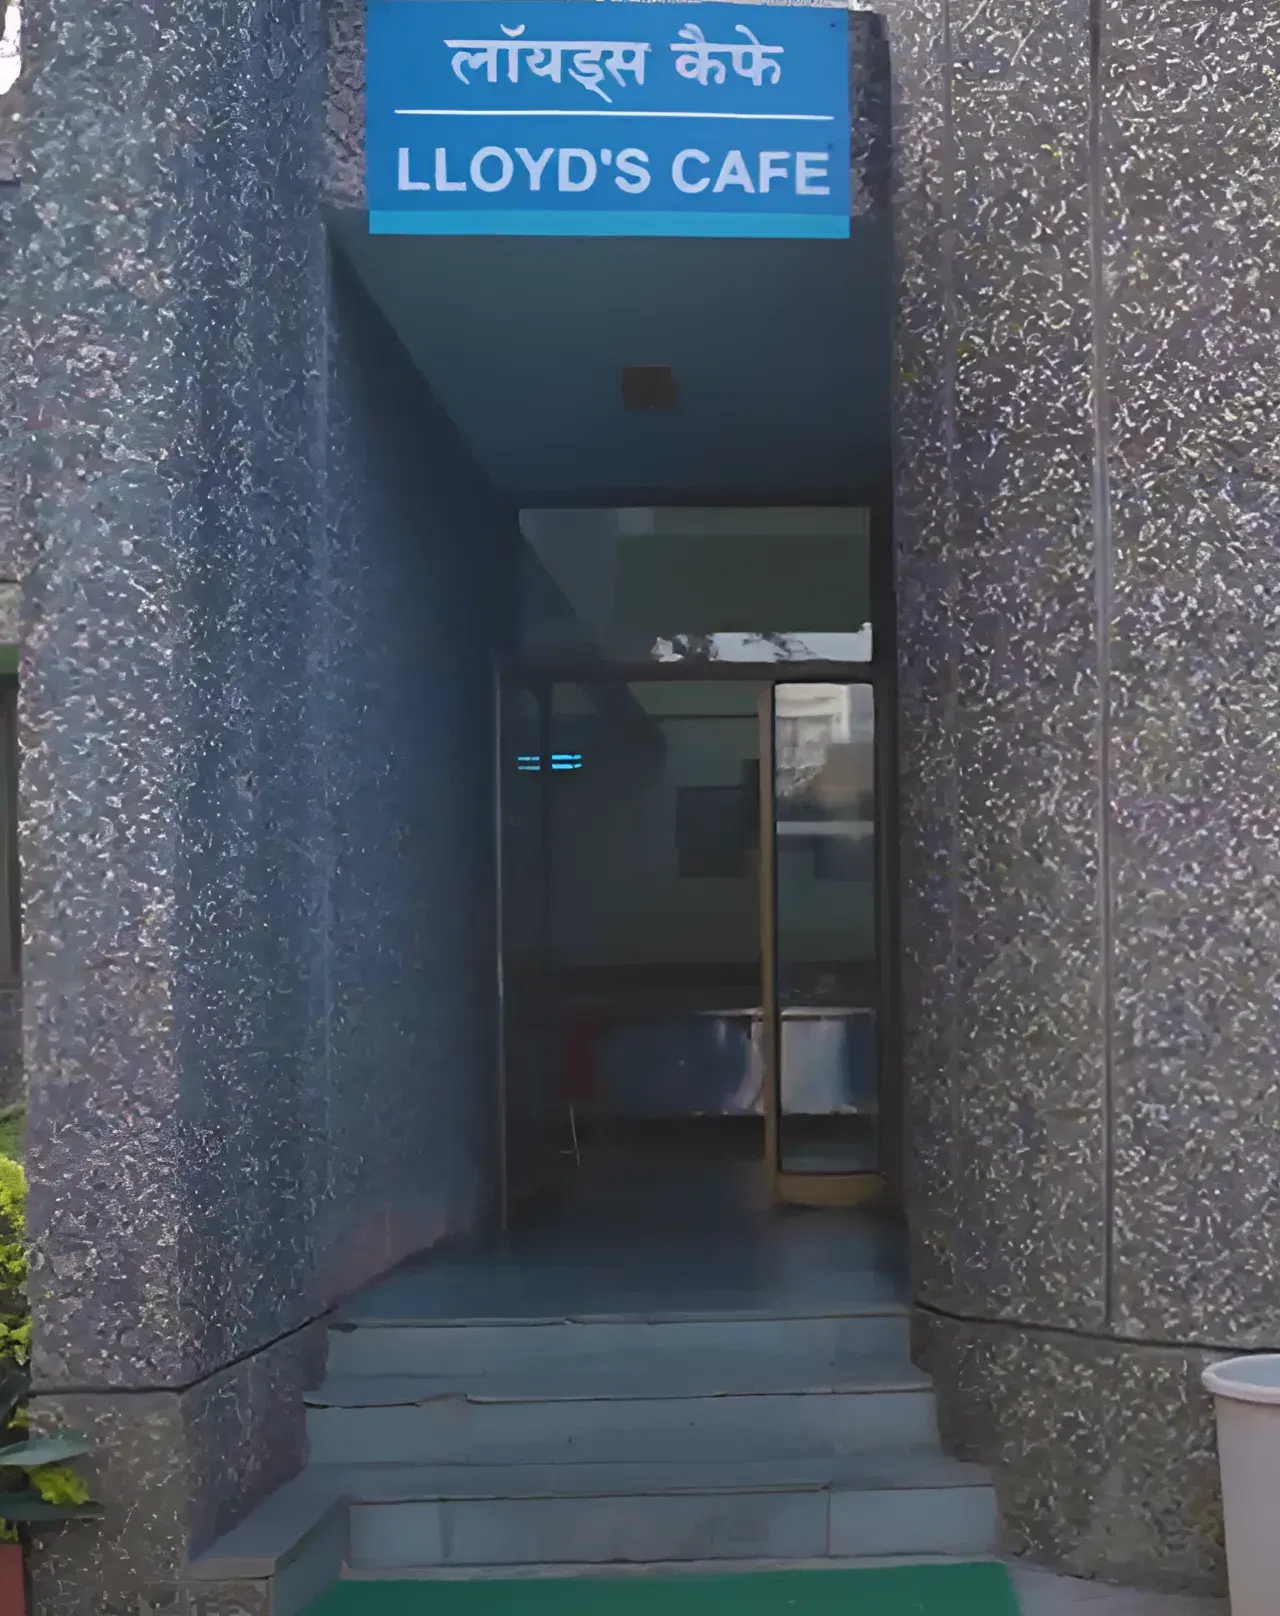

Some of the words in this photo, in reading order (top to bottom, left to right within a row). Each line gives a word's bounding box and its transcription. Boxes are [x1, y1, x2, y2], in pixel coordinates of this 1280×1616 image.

[443, 23, 651, 103] लॉयड्स
[669, 22, 784, 87] कैफे
[397, 145, 651, 193] LLOYD'S
[671, 148, 830, 195] CAFE
